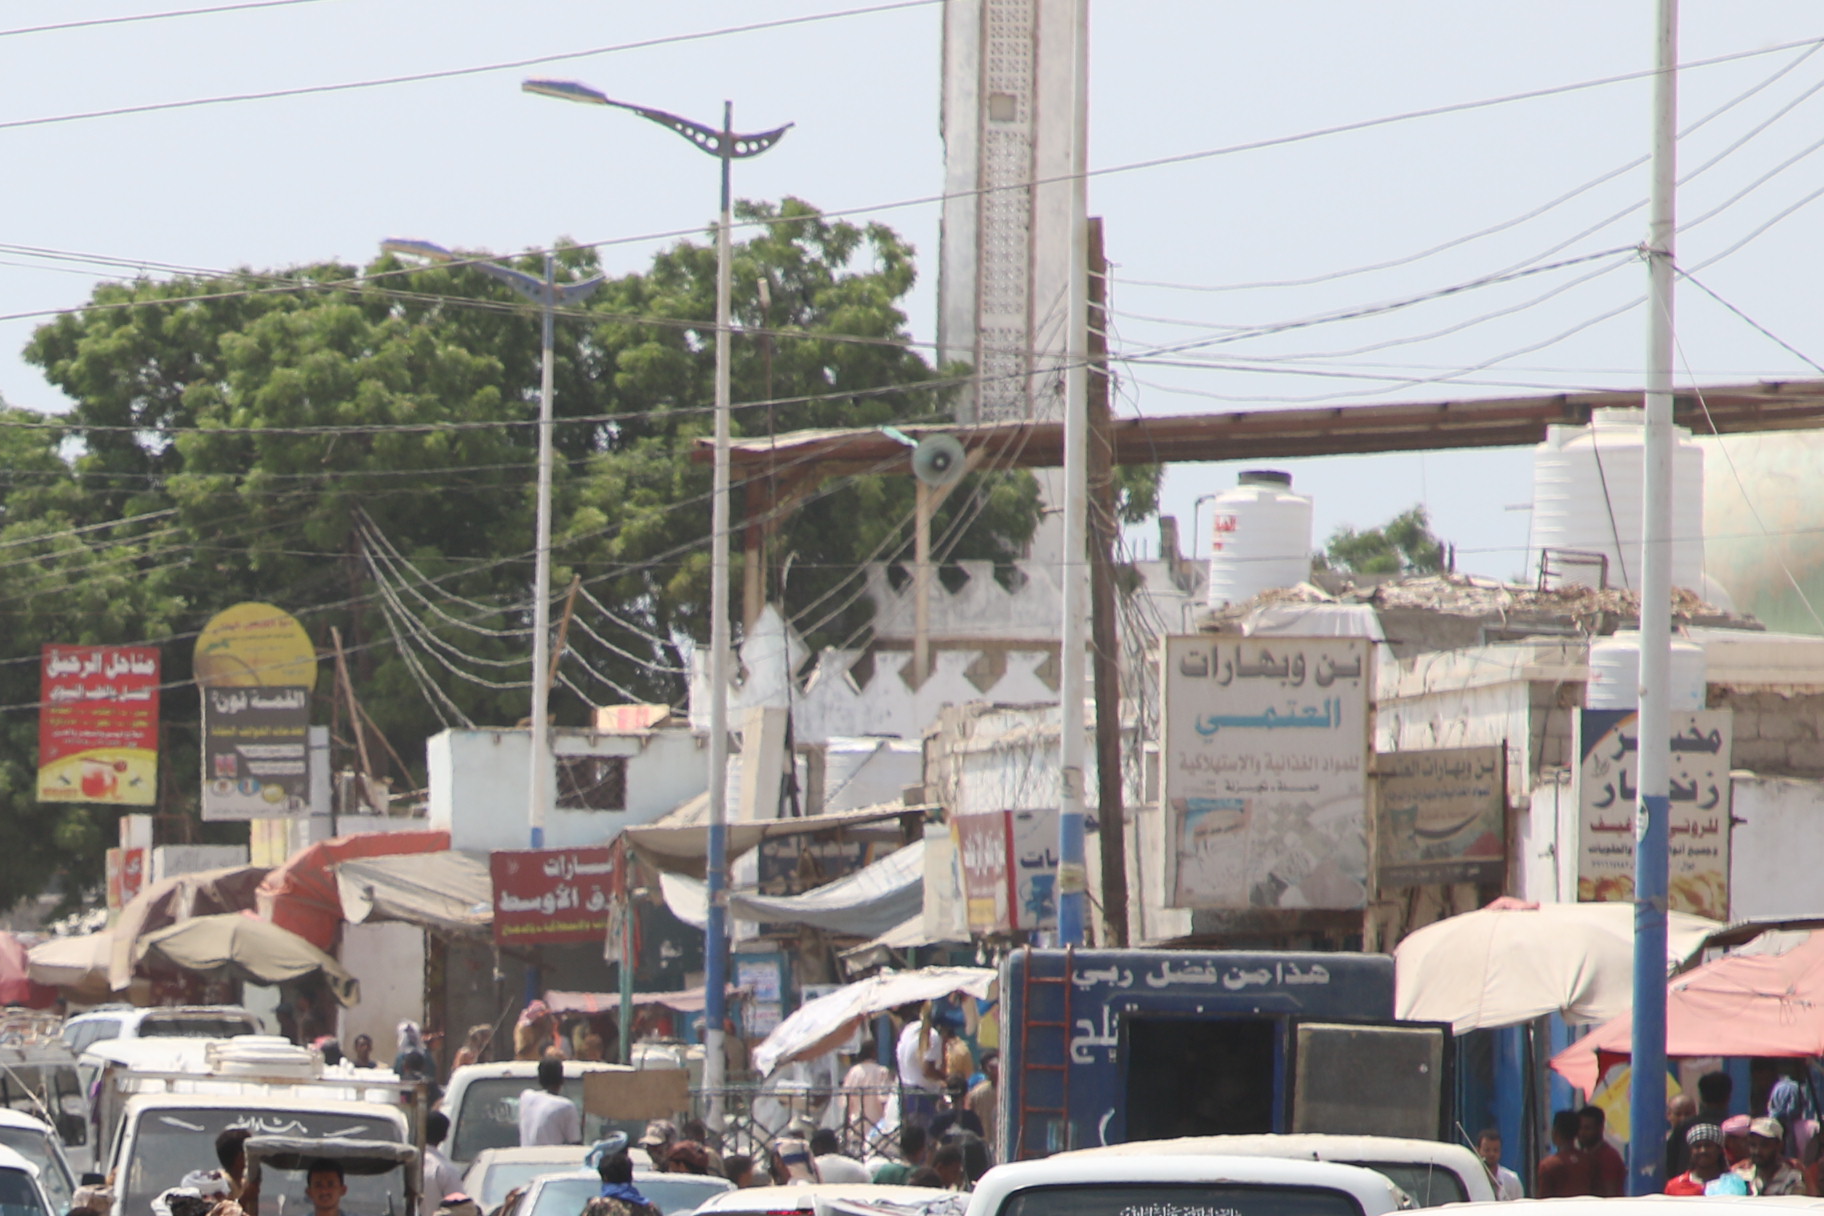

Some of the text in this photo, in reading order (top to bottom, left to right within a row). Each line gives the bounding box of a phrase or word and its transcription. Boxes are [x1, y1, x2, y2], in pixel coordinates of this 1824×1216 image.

[104, 643, 155, 679] مناحل
[1179, 645, 1307, 687] وبهارات
[1195, 697, 1342, 744] العتمي
[1263, 752, 1318, 777] الغذائية
[1591, 771, 1720, 809] زنجار
[499, 883, 580, 915] الأوسط
[1072, 960, 1330, 991] هذا من فضل ربي
